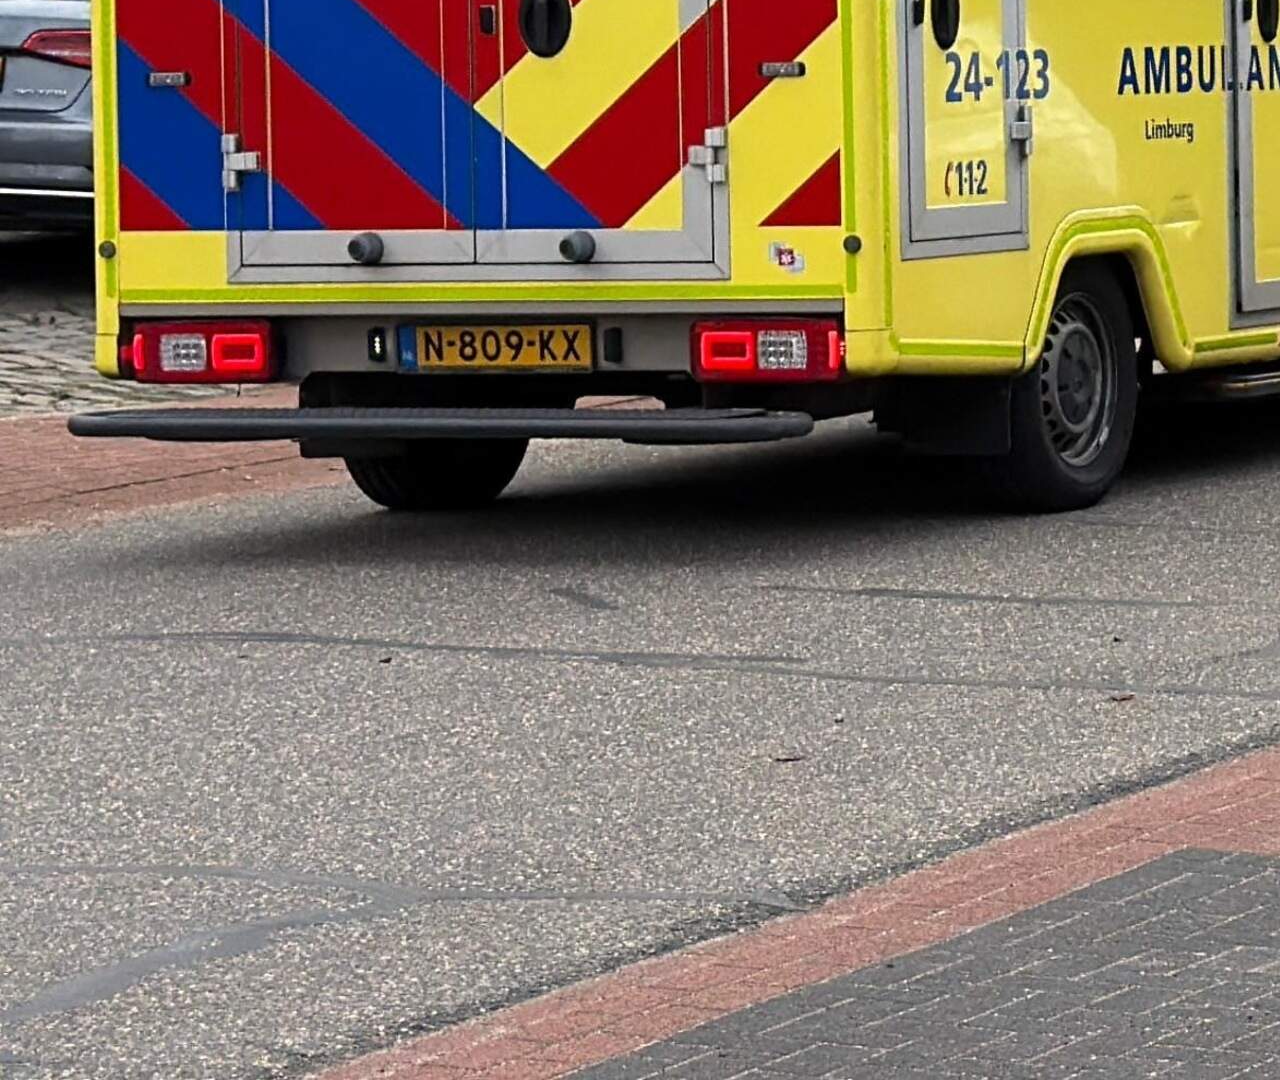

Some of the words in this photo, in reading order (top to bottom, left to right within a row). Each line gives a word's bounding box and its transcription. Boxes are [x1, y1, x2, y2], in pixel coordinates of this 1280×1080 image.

[944, 48, 1050, 103] 24-123
[1144, 119, 1194, 143] Limburg
[423, 329, 581, 362] N-809-KX
